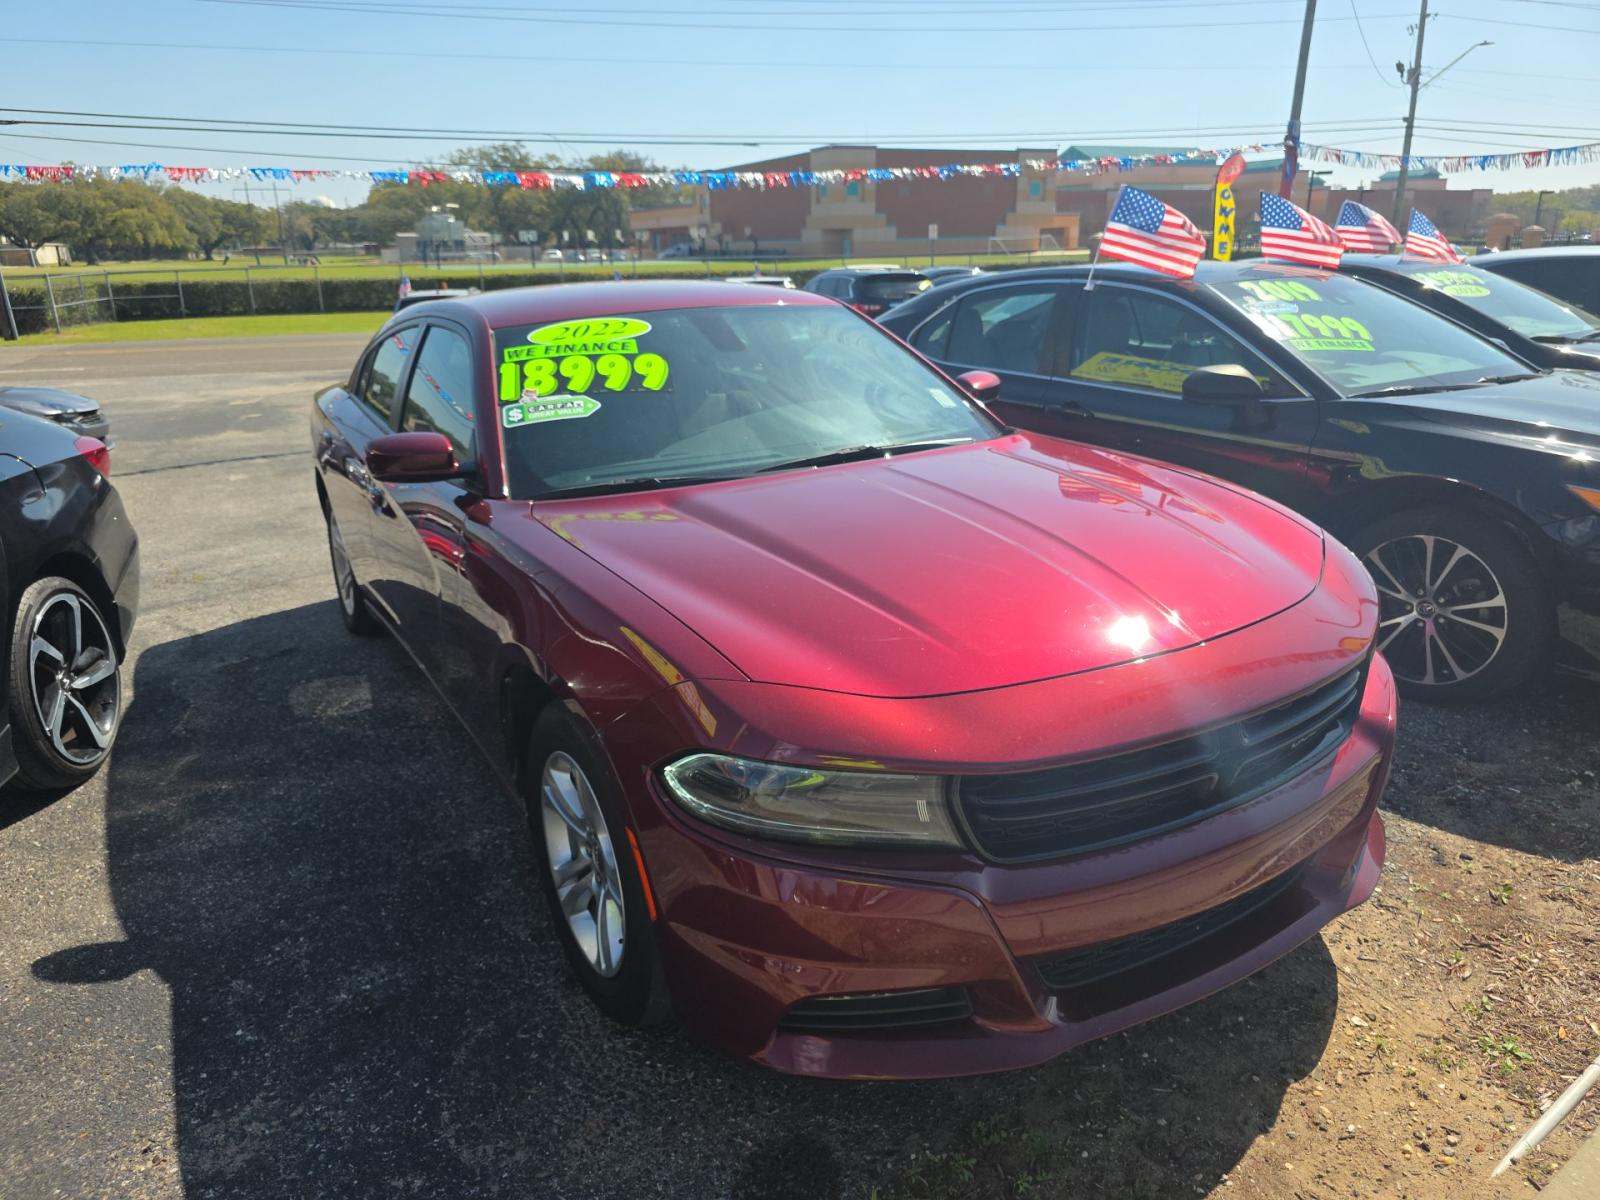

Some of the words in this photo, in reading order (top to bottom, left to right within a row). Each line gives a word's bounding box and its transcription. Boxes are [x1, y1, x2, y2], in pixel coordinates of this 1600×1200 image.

[553, 321, 628, 341] 2022
[507, 347, 535, 360] WE
[544, 341, 632, 355] FINANCE
[500, 353, 669, 401] 18999
